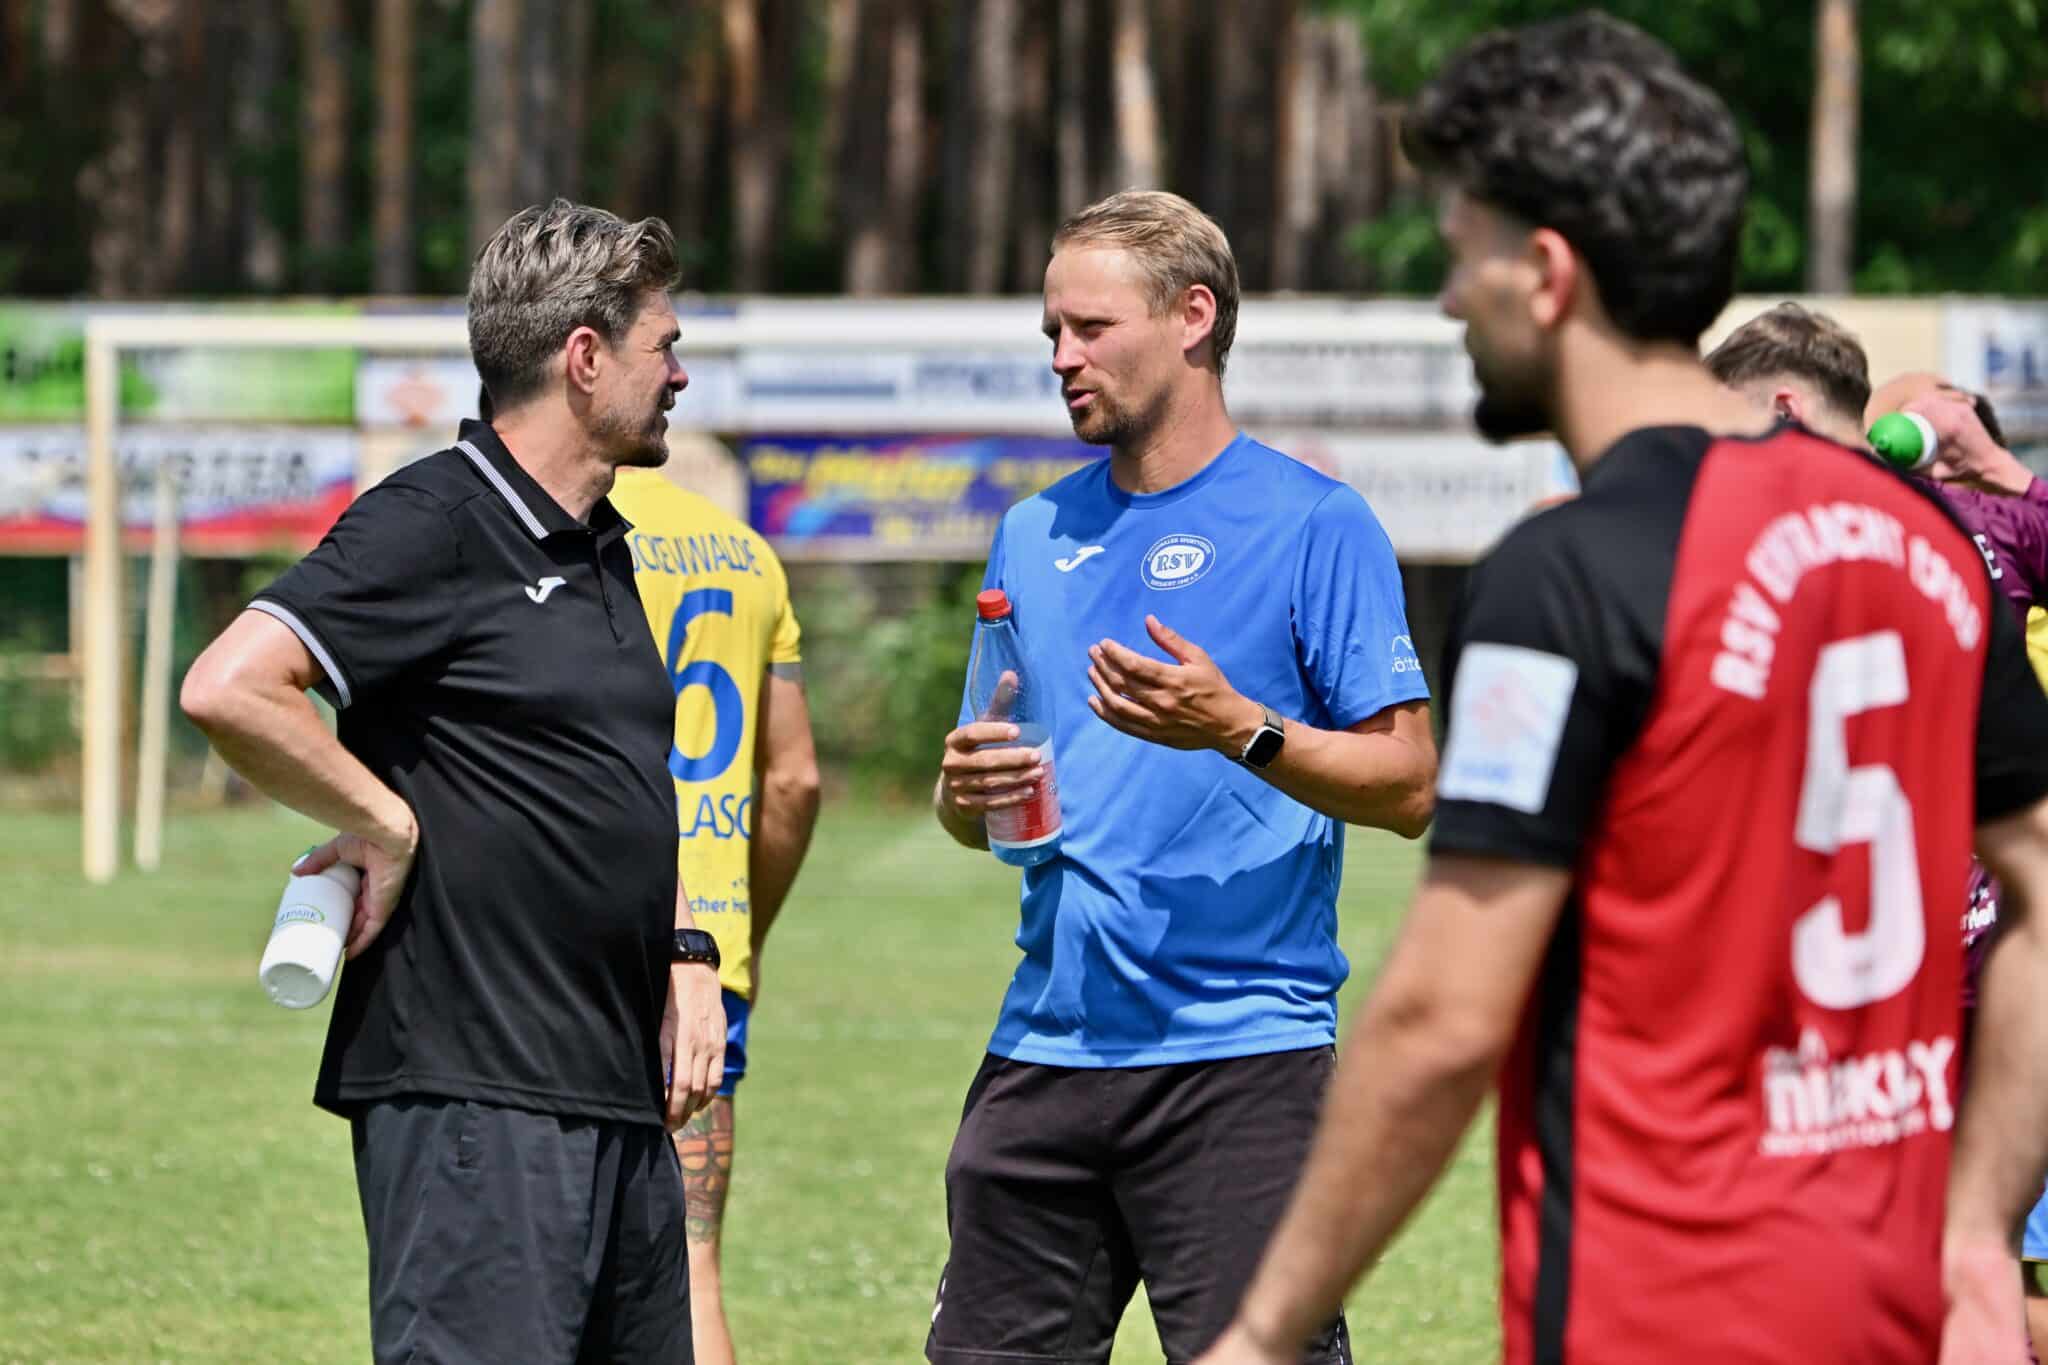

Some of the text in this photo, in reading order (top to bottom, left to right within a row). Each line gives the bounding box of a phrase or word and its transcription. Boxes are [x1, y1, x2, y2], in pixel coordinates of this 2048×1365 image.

[1155, 552, 1200, 573] RSV
[1710, 580, 1781, 700] RSV
[667, 587, 744, 783] 6
[1791, 628, 1926, 1011] 5
